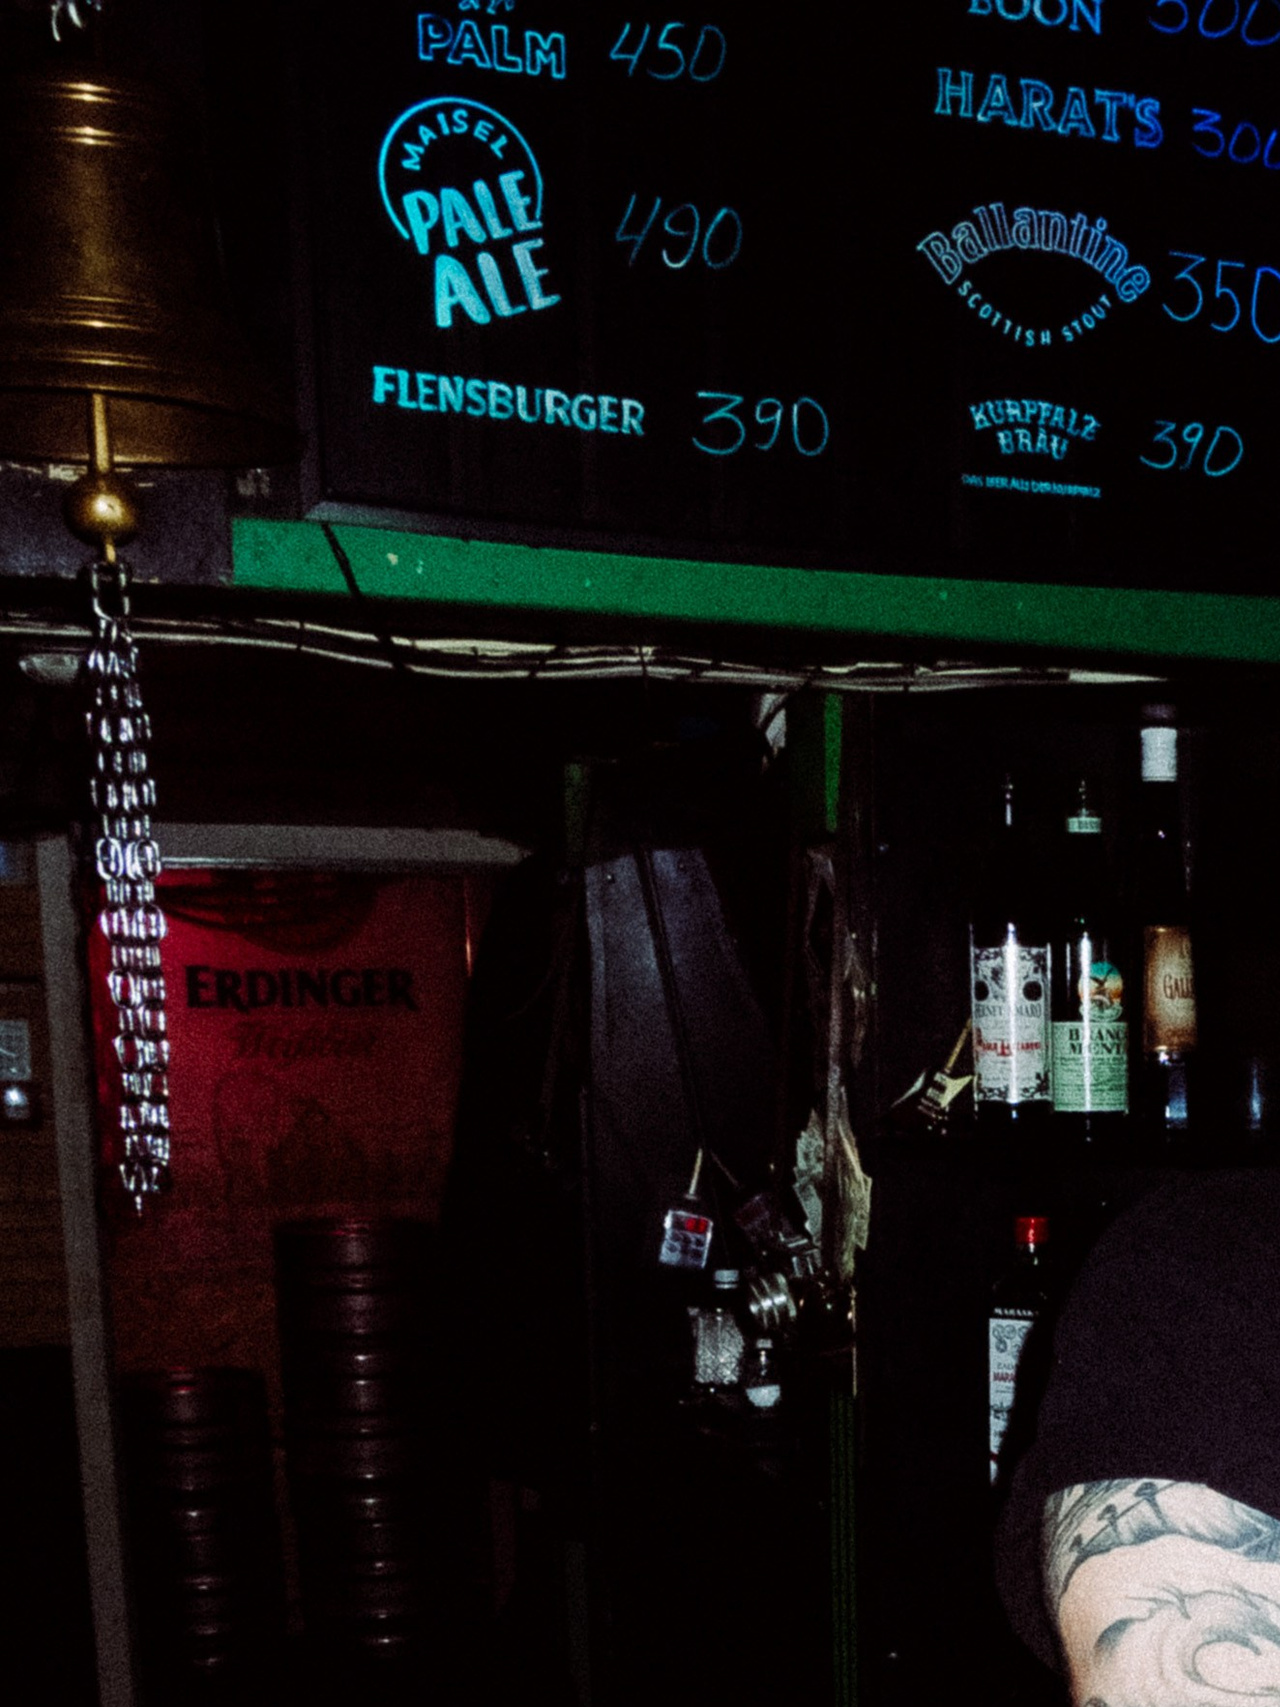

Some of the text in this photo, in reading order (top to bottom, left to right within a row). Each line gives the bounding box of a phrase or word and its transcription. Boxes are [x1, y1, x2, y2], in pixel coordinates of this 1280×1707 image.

[416, 12, 567, 80] PALM
[609, 21, 727, 82] 450
[401, 109, 509, 171] MAISEL
[401, 169, 544, 256] PALE
[614, 193, 743, 270] 490
[434, 237, 562, 328] ALE
[915, 202, 1152, 303] Ballantine
[957, 279, 1112, 348] SCOTTISH STOUT
[371, 364, 646, 436] FLENSBURGER
[691, 391, 830, 457] 390
[968, 398, 1102, 442] KURPFALZ
[1140, 419, 1244, 477] 390
[184, 964, 418, 1012] ERDINGER
